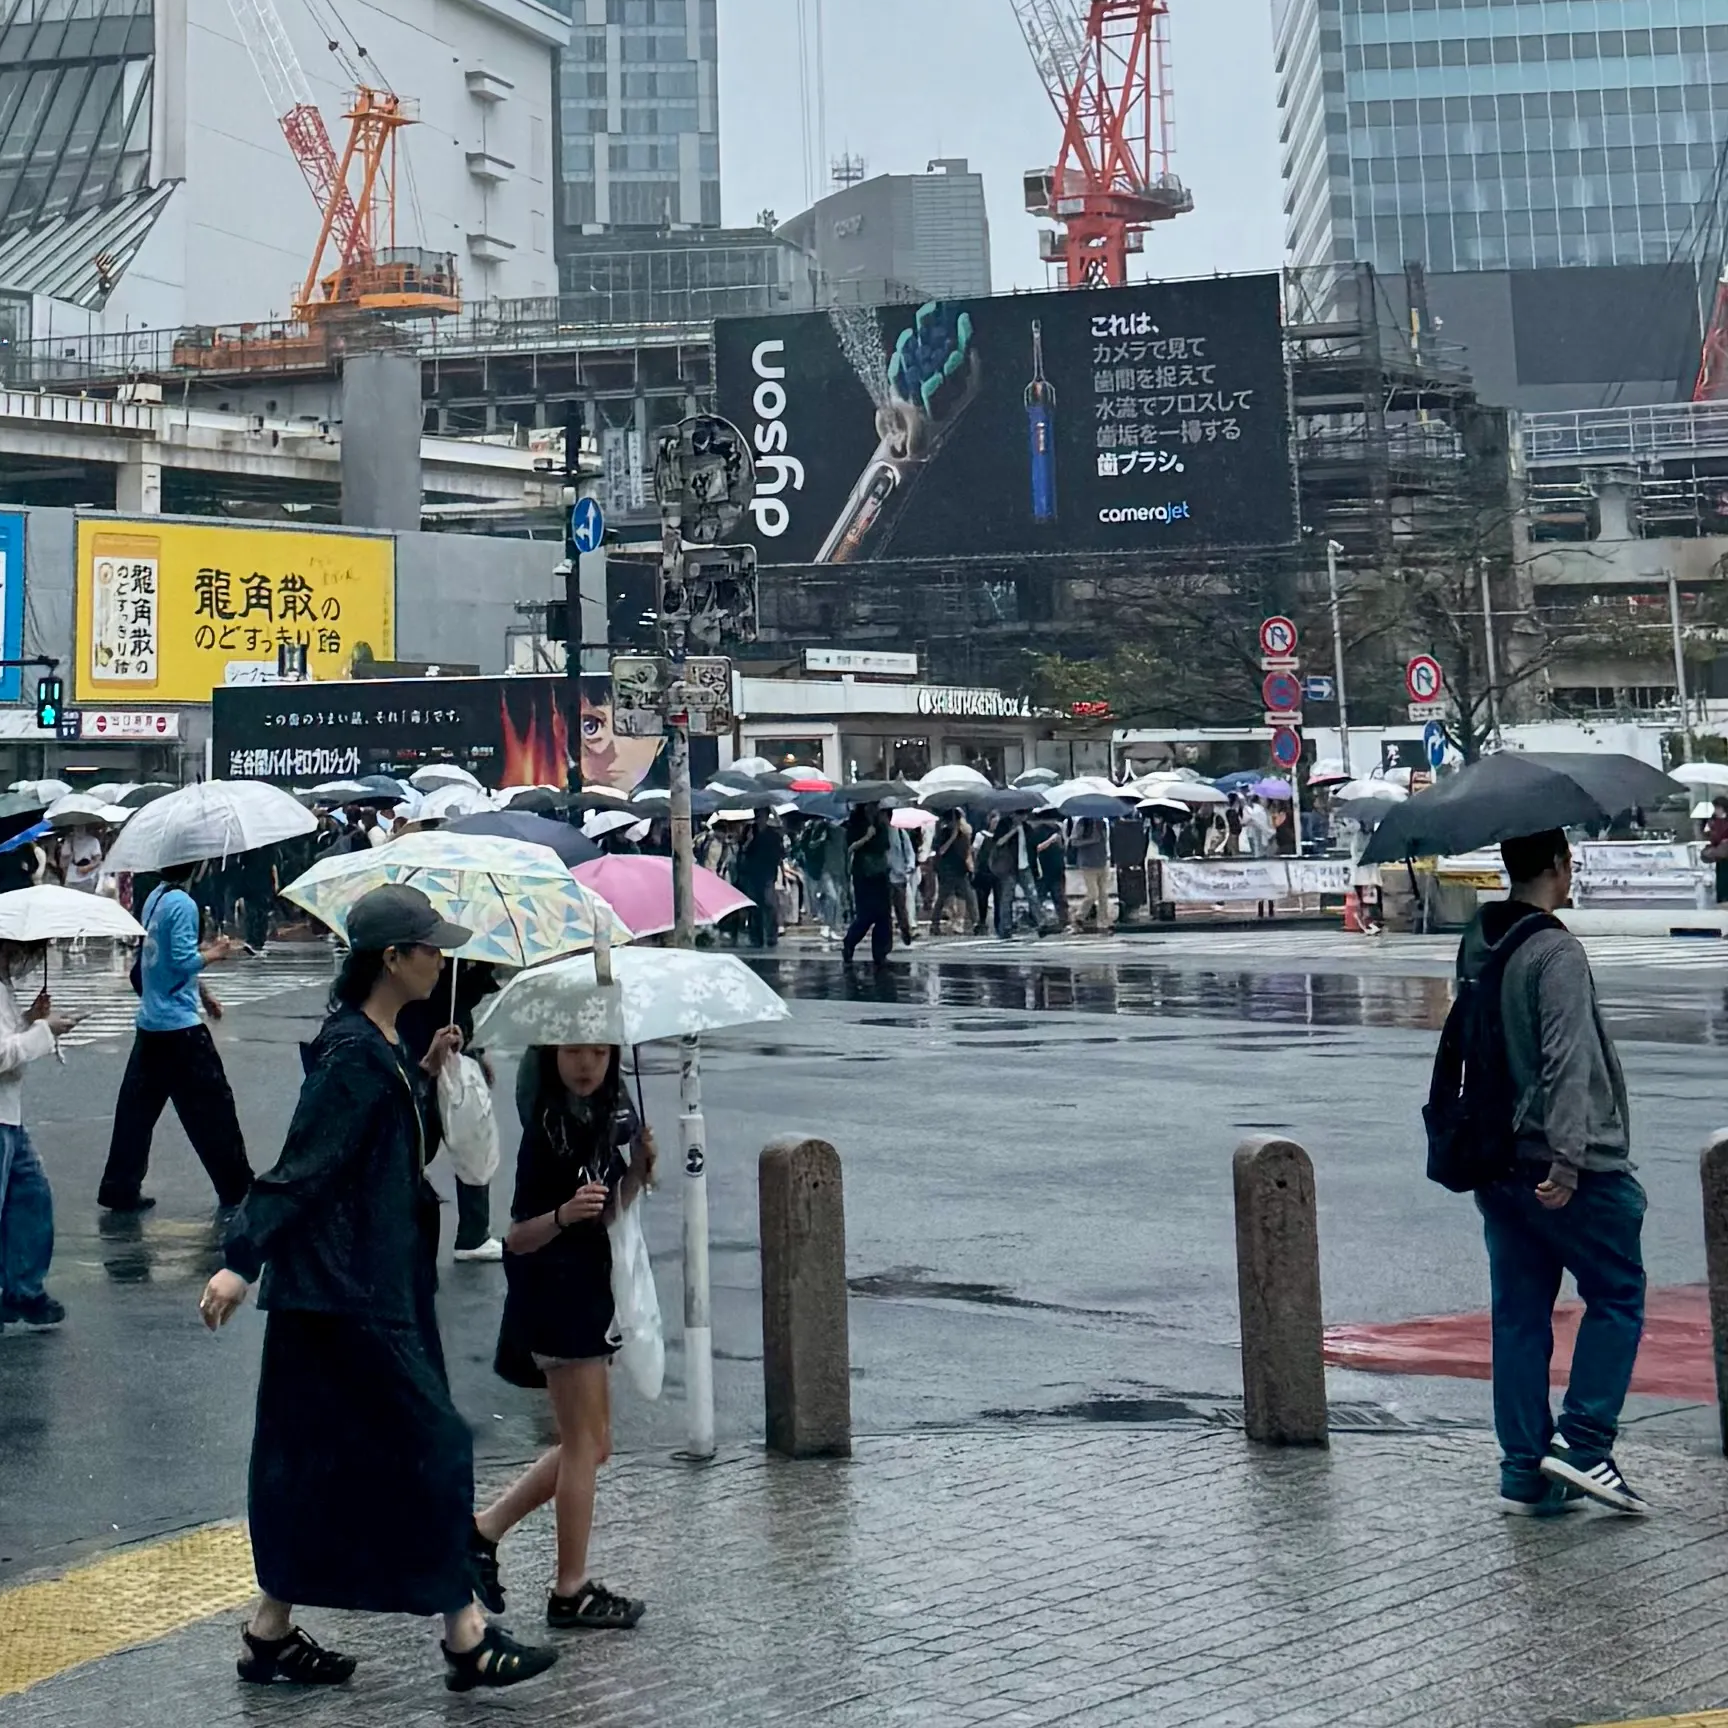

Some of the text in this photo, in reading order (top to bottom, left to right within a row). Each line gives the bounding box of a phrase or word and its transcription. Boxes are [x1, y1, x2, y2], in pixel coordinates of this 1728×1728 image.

[1091, 312, 1160, 338] これは、
[1092, 336, 1207, 365] カメラで見て
[1093, 364, 1217, 393] 歯間を捉えて
[1095, 389, 1254, 421] 水流でフロスして
[748, 339, 805, 537] dyson
[1096, 450, 1186, 477] 歯ブラシ。
[1098, 500, 1191, 524] camerajet
[194, 567, 341, 623] 龍角散の
[129, 564, 156, 674] 龍角散の
[194, 624, 341, 654] のどすっきり飴
